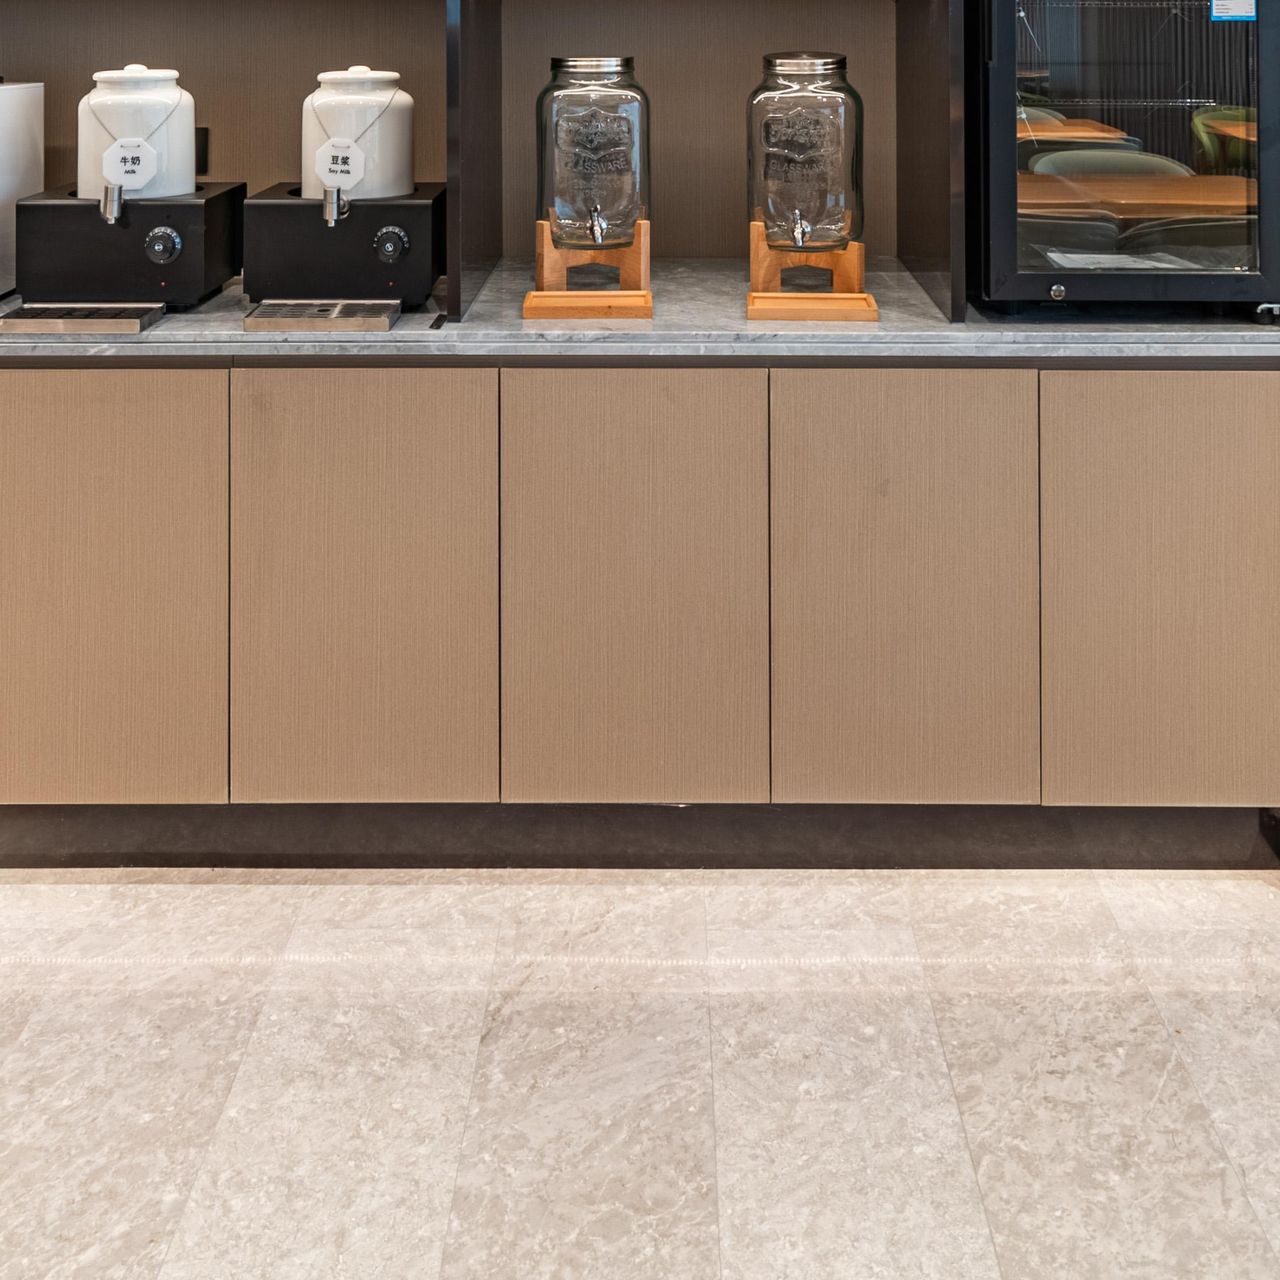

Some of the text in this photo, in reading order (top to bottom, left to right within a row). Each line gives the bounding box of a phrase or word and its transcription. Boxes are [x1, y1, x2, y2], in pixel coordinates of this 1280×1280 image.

[120, 155, 141, 166] 牛奶
[330, 155, 350, 166] 豆浆
[328, 167, 338, 175] Soy
